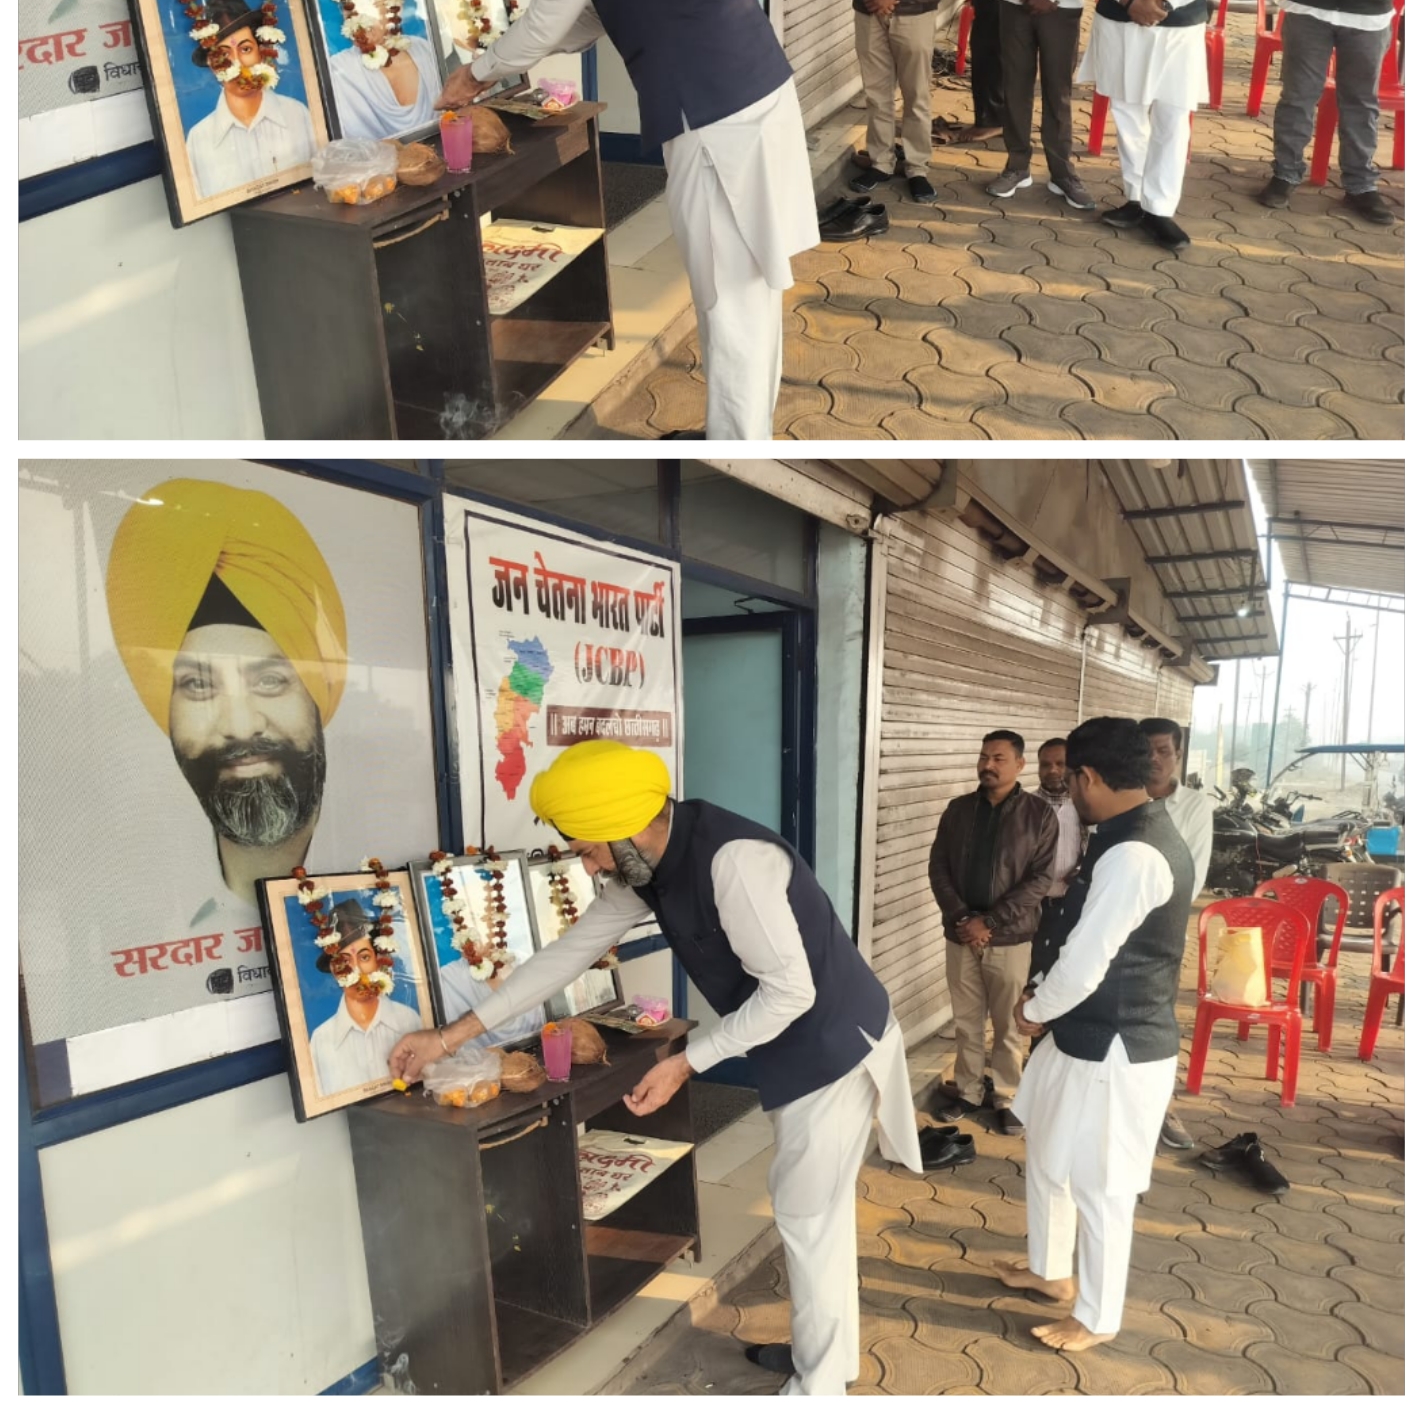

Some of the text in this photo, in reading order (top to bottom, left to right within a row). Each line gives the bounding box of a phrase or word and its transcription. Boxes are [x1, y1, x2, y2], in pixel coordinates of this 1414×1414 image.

[489, 551, 665, 638] जन चेतना भारत पार्टी
[574, 641, 645, 689] (JCBP)
[562, 717, 576, 736] अब
[578, 717, 594, 736] हमन
[110, 932, 224, 978] सरदार
